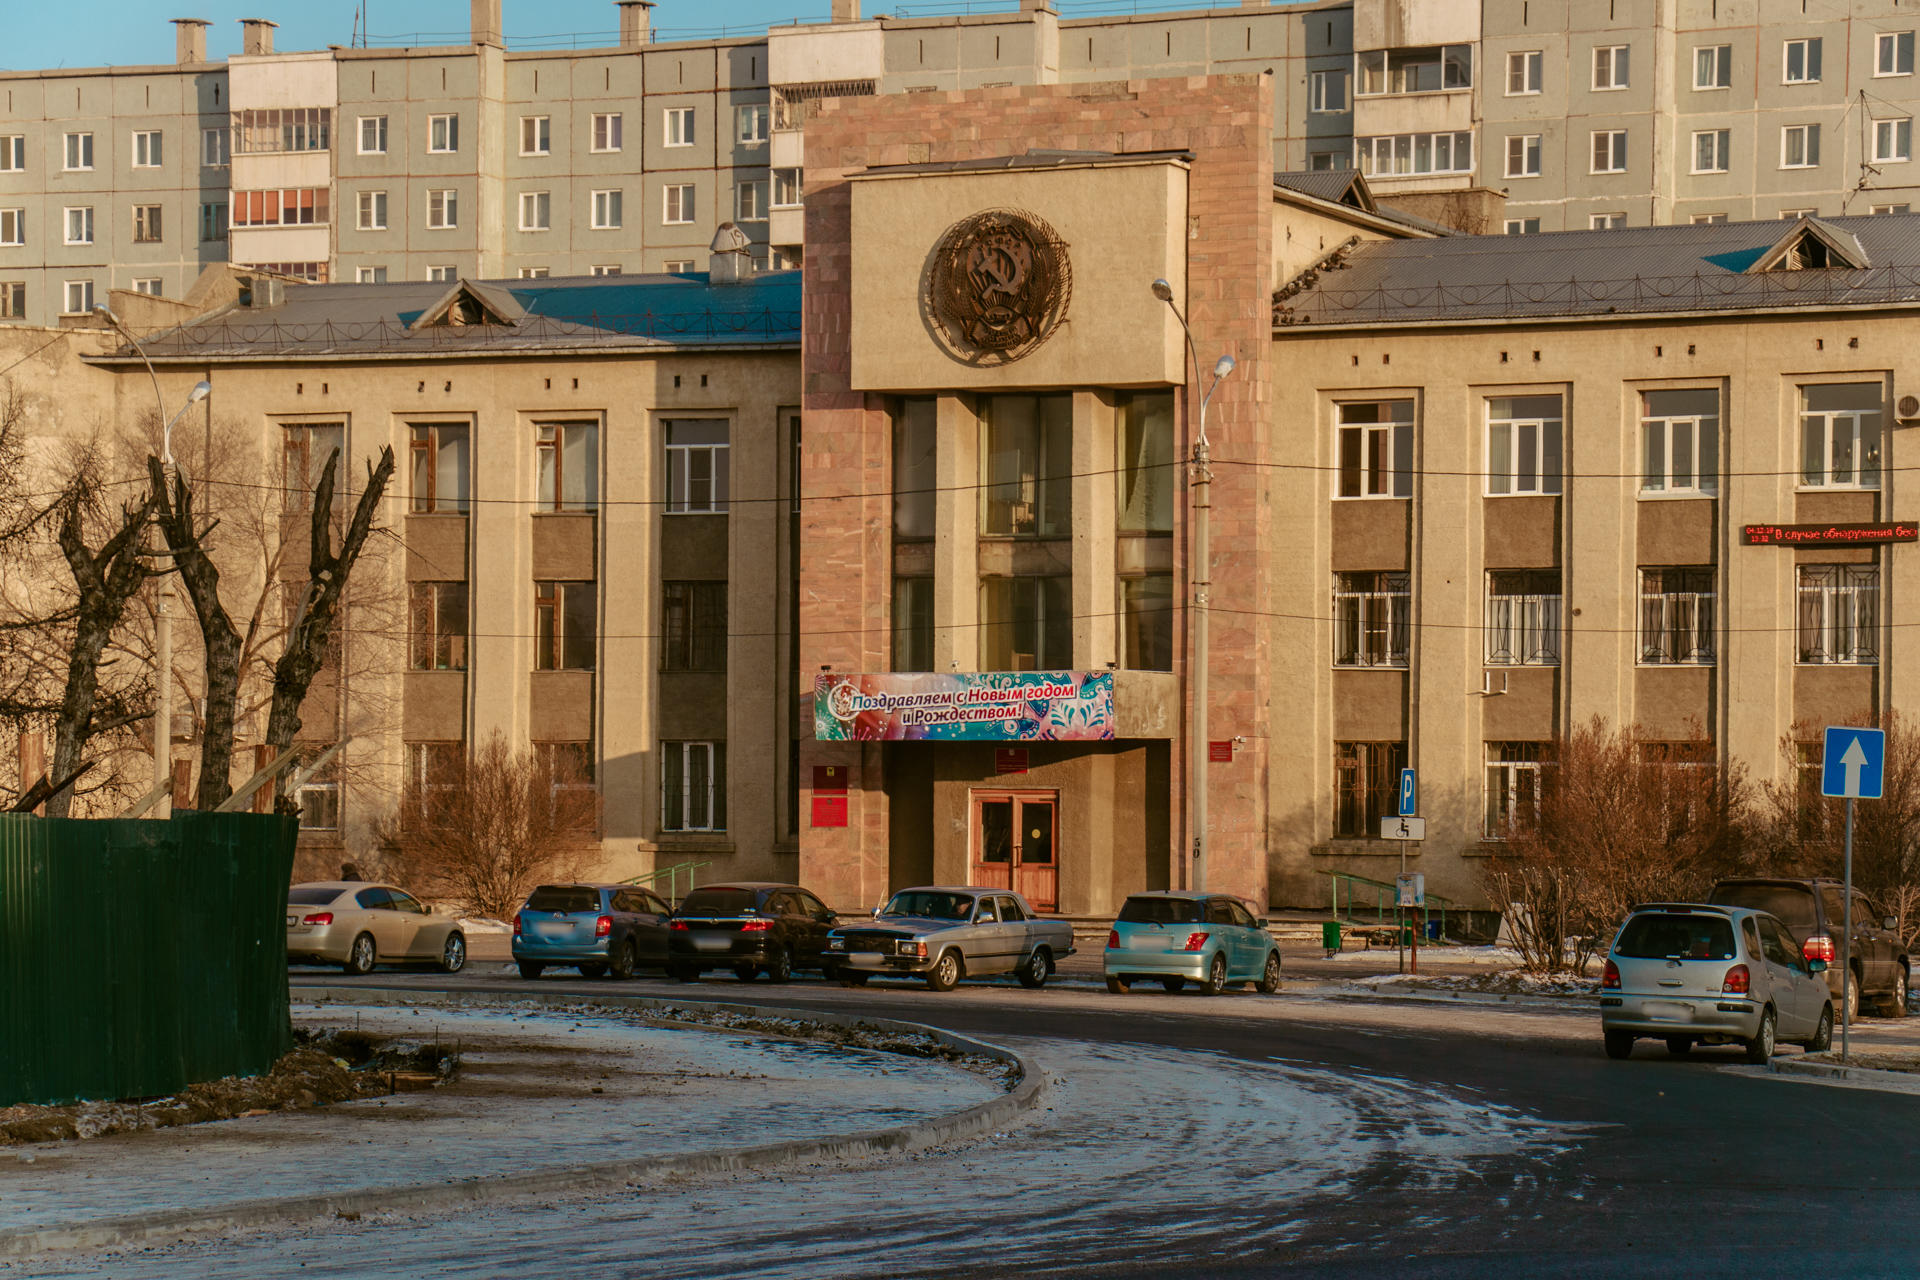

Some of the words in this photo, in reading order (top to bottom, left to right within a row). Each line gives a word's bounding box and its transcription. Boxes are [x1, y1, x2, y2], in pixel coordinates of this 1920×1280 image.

[1775, 529, 1783, 540] В
[1785, 530, 1820, 542] случае
[1823, 527, 1893, 541] обнаружения
[851, 692, 953, 711] Поздравляем
[956, 692, 964, 703] с
[968, 688, 1023, 702] Новым
[1026, 683, 1074, 699] годом
[902, 712, 911, 724] и
[914, 703, 1022, 723] Рождеством!
[1403, 775, 1412, 810] P
